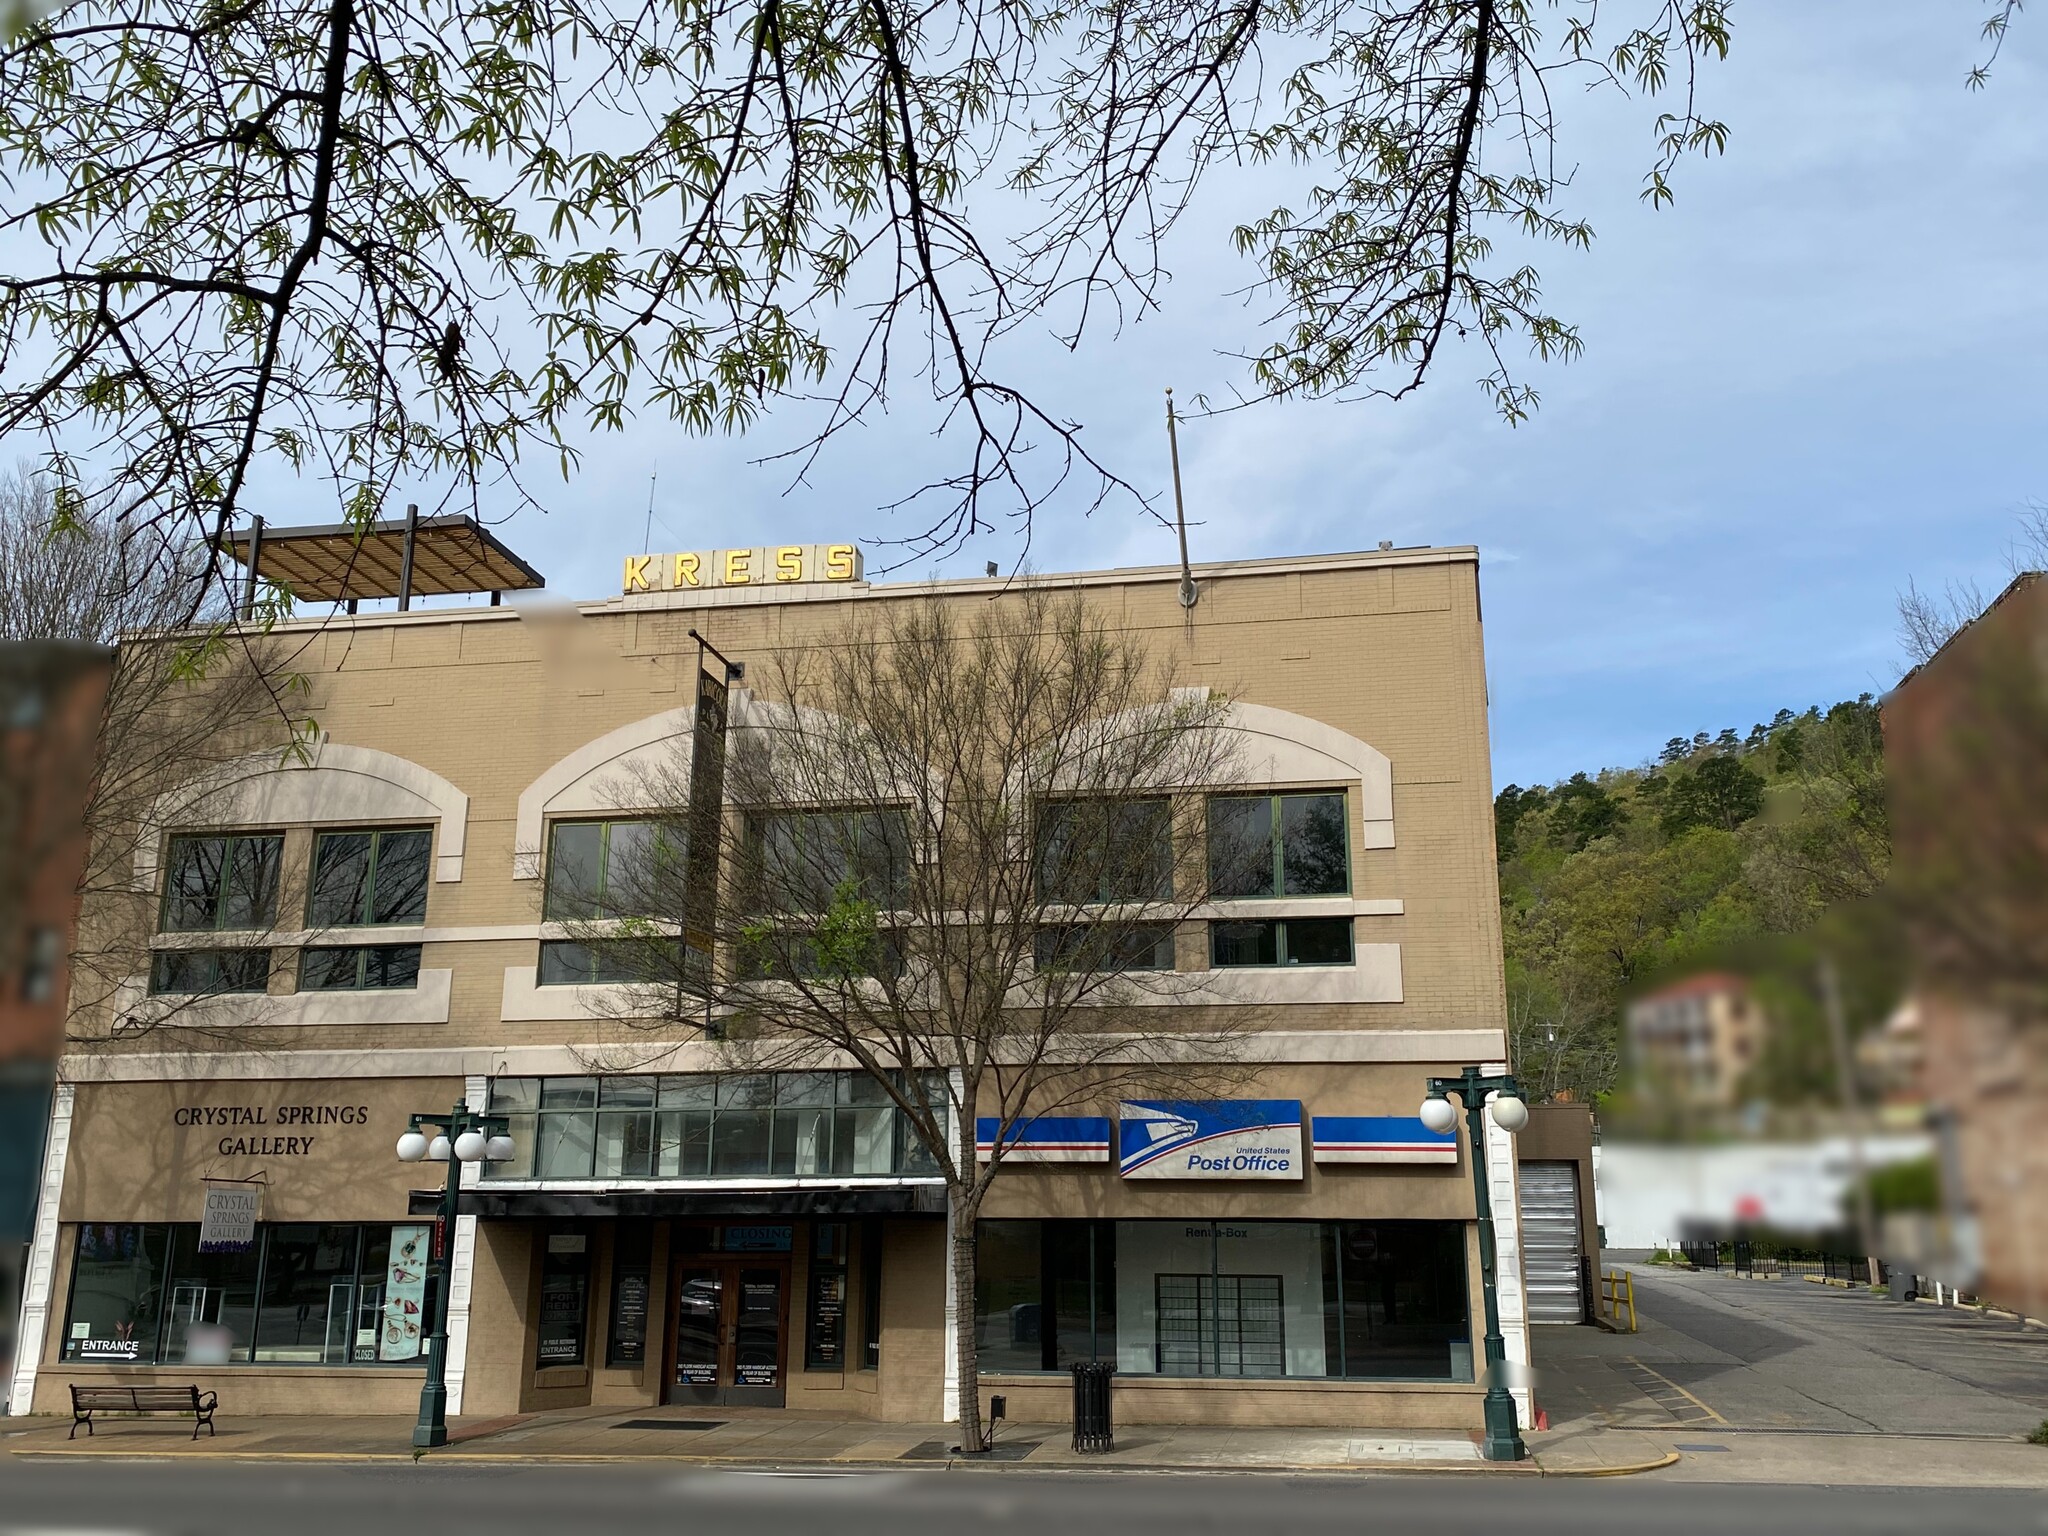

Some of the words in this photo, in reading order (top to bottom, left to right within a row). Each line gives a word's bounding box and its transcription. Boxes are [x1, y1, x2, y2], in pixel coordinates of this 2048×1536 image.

[624, 545, 853, 591] KRESS
[174, 1106, 268, 1126] CRYSTAL
[276, 1106, 368, 1125] SPRINGS
[218, 1136, 314, 1156] GALLERY
[1264, 1147, 1291, 1155] States
[1187, 1155, 1231, 1171] Post
[1232, 1155, 1290, 1171] Office
[208, 1194, 255, 1211] CRYSTAL
[211, 1211, 250, 1224] SPRINGS
[210, 1226, 248, 1238] GALLERY
[730, 1227, 792, 1239] CLOSING
[549, 1293, 574, 1301] FOR
[545, 1301, 577, 1310] RENT
[82, 1340, 139, 1351] ENTRANCE
[541, 1345, 577, 1354] ENTRANCE
[354, 1349, 375, 1360] CLOSED
